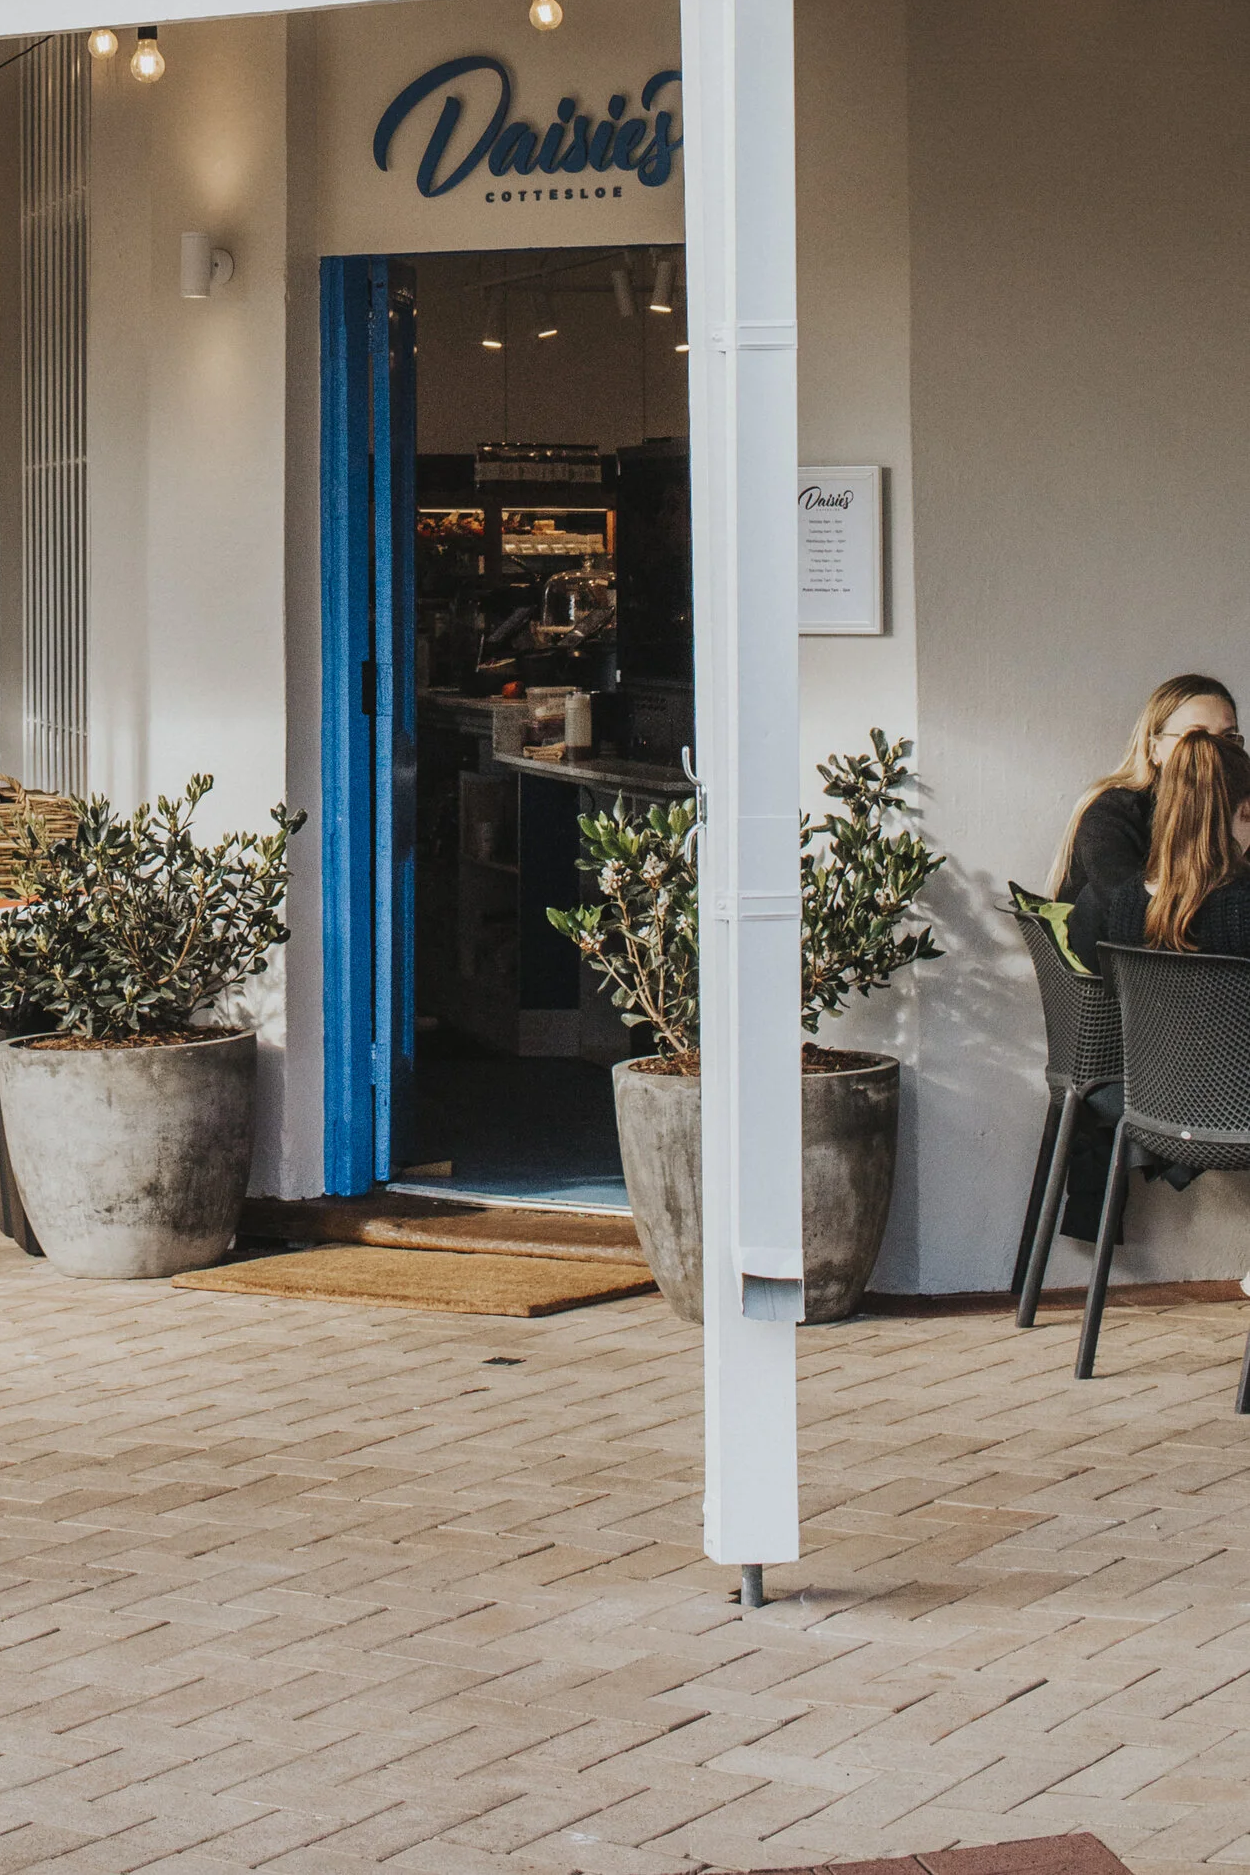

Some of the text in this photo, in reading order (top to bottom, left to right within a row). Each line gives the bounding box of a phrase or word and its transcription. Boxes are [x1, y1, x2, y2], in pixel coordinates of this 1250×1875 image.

[373, 55, 683, 198] Daisies
[485, 186, 623, 203] COTTESLOE
[798, 486, 854, 510] Daisies
